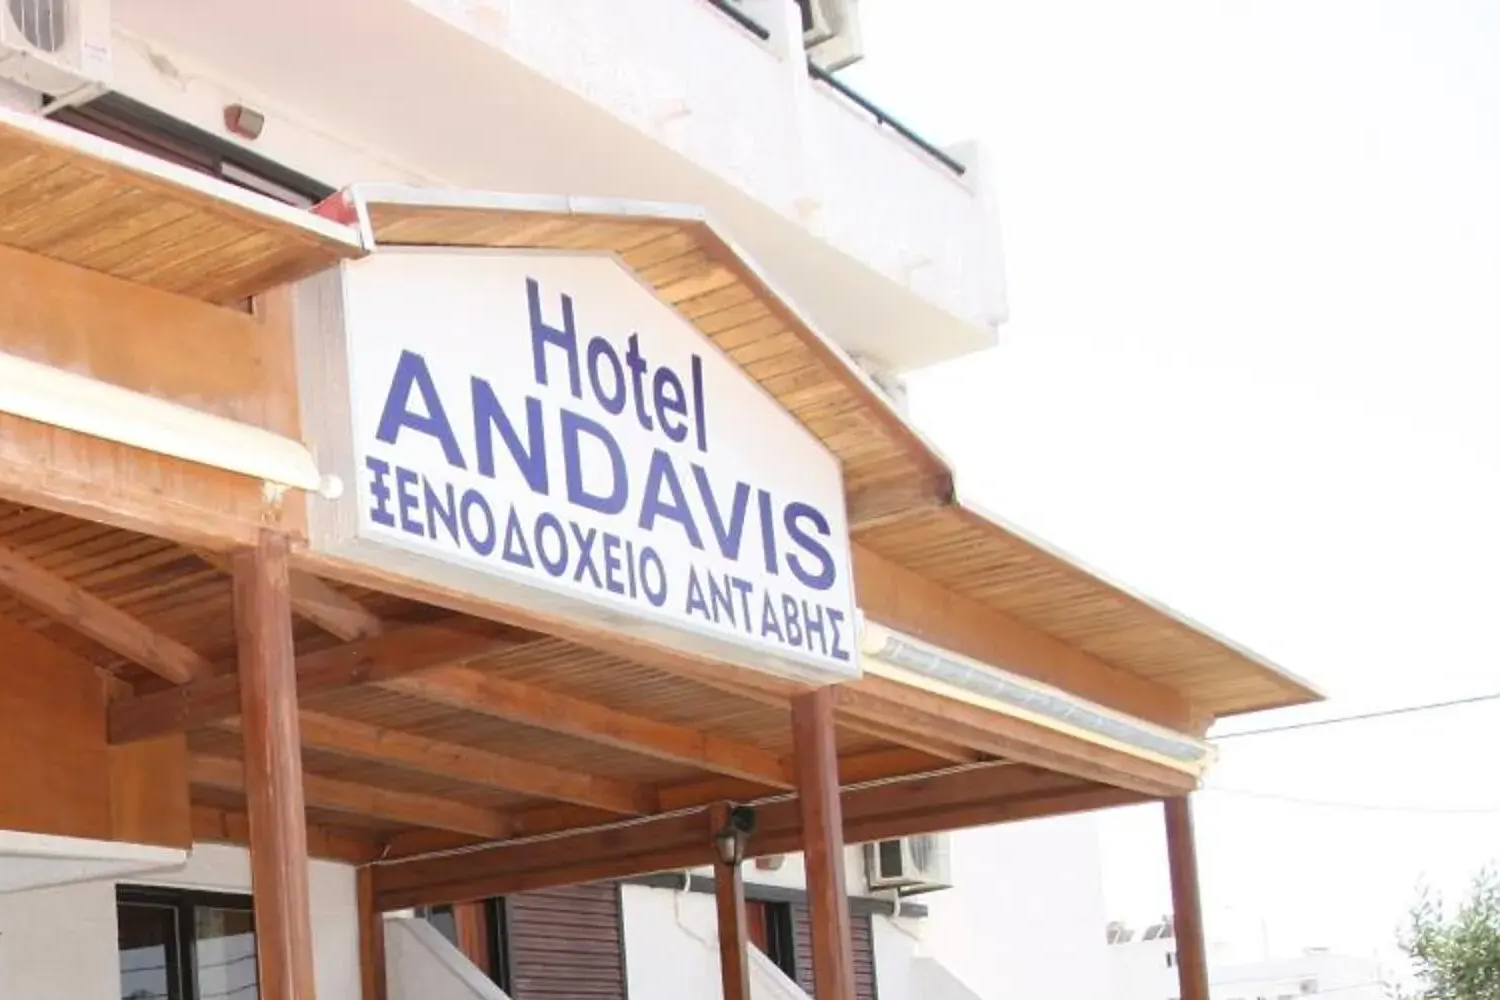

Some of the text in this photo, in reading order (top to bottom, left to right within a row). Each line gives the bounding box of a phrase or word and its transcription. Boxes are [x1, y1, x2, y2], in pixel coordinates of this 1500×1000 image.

[526, 278, 708, 453] Hotel
[365, 455, 851, 661] ΞΕΝΟΔΟΧΕΙΟ ΑΝΤΑΒΗΣ
[375, 349, 838, 592] ANDAVIS
